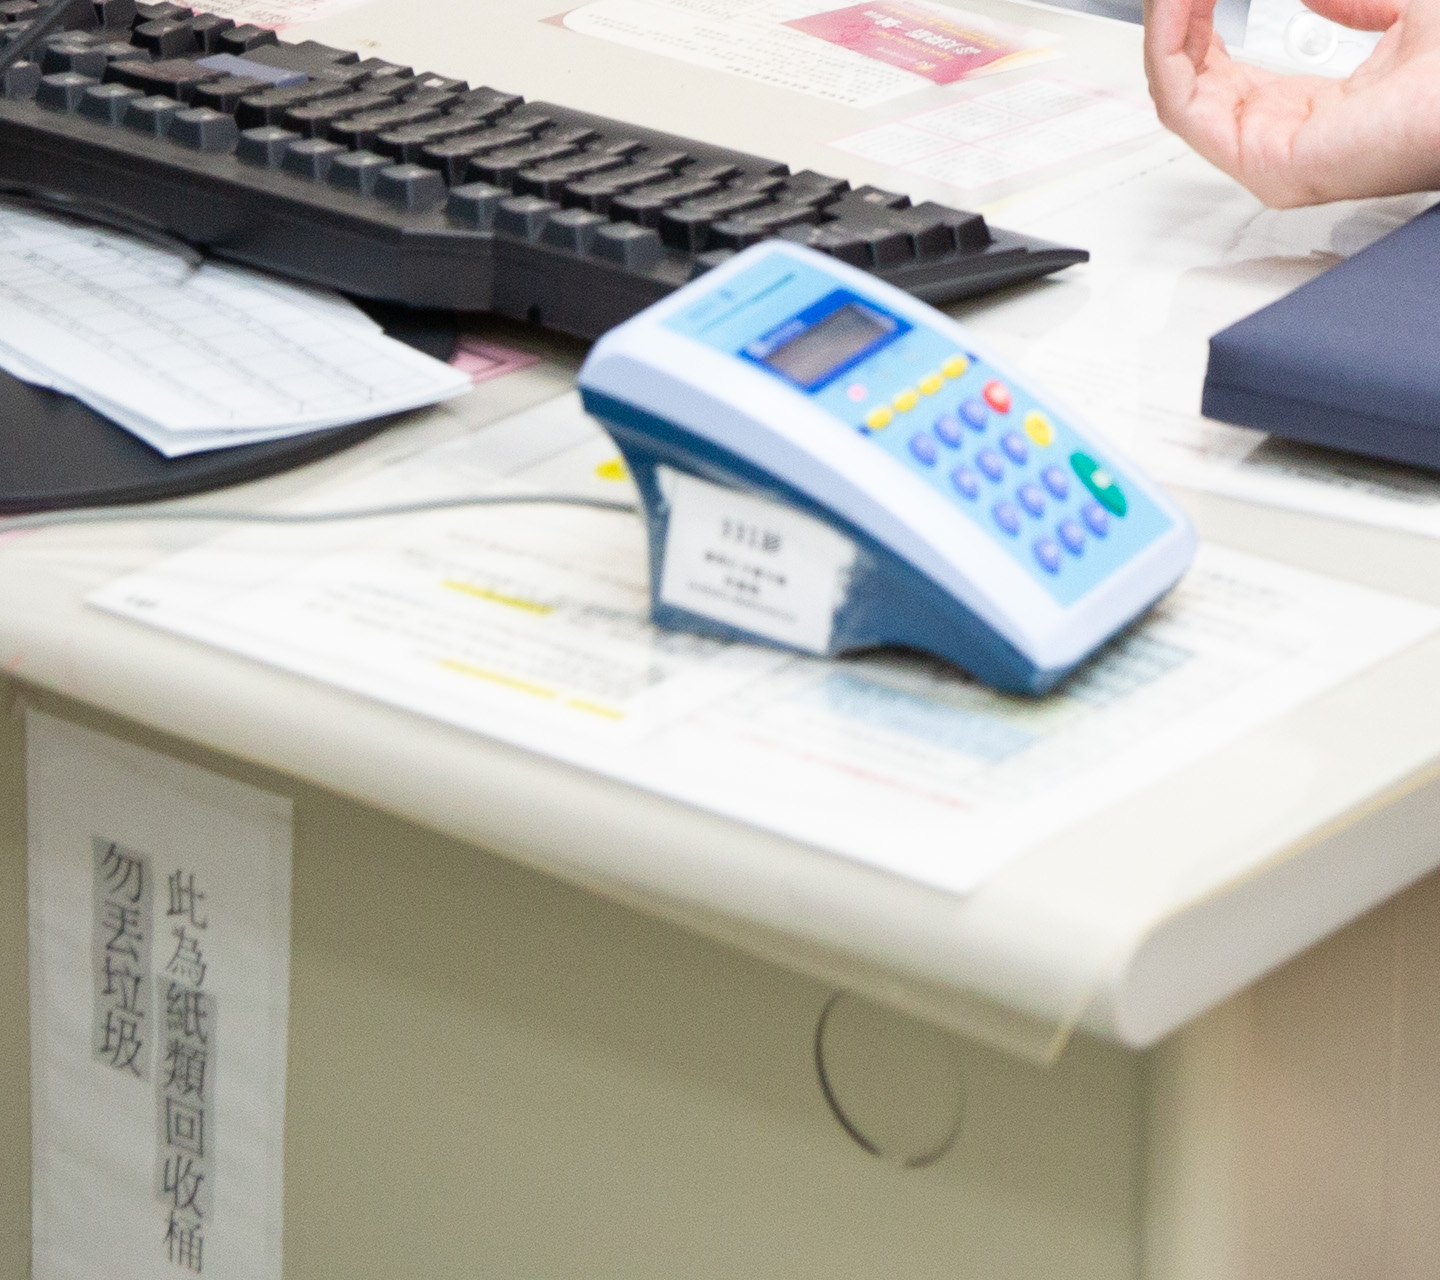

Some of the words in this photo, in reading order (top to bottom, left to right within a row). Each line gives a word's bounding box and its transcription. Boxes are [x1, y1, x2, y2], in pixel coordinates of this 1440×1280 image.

[100, 840, 146, 1078] 勿丟垃圾
[162, 868, 209, 1276] 此為紙類回收桶
